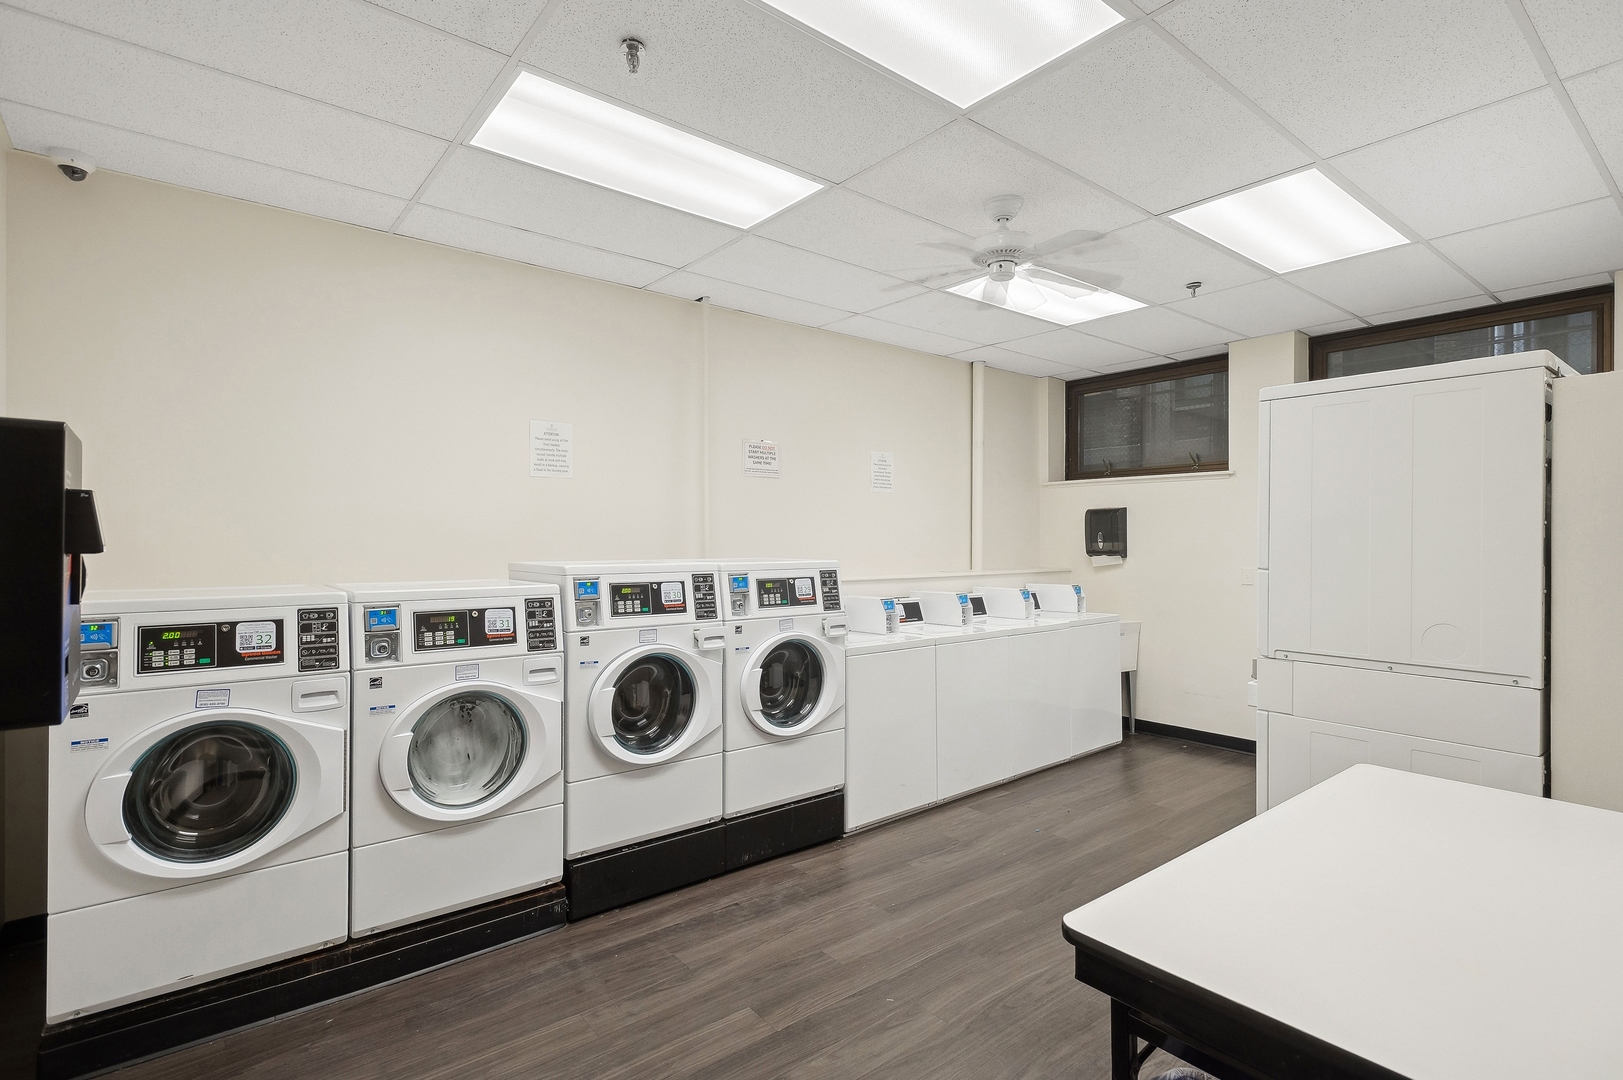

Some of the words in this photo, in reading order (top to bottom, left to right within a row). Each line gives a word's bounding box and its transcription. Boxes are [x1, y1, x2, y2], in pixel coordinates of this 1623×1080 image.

[672, 591, 682, 599] 30
[499, 619, 511, 628] 31
[162, 631, 181, 640] 2.00
[255, 633, 273, 645] 32
